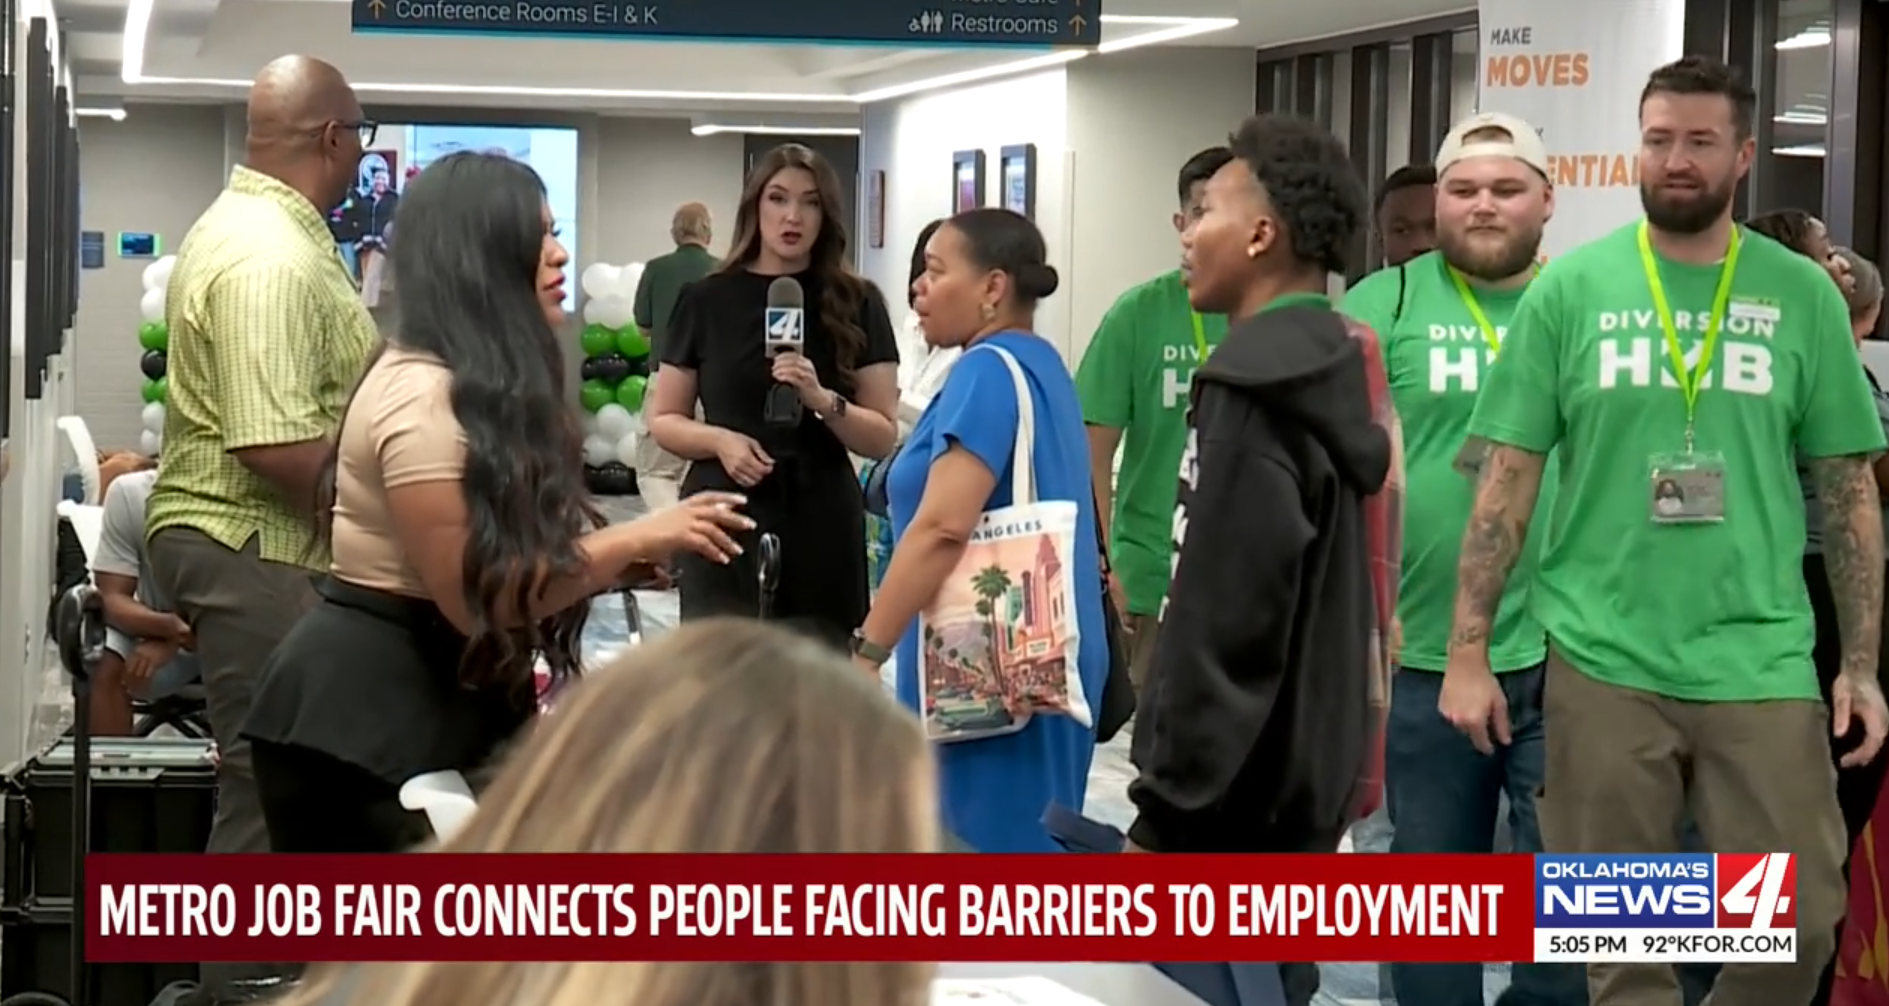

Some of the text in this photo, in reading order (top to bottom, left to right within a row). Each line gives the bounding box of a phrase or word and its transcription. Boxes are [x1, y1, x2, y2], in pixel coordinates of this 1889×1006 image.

[396, 0, 658, 24] Conference Rooms E-I & K
[952, 13, 1058, 34] Restrooms
[1490, 27, 1532, 46] MAKE
[1486, 53, 1589, 87] MOVES
[770, 311, 800, 341] 4
[971, 520, 1043, 541] ANGELES
